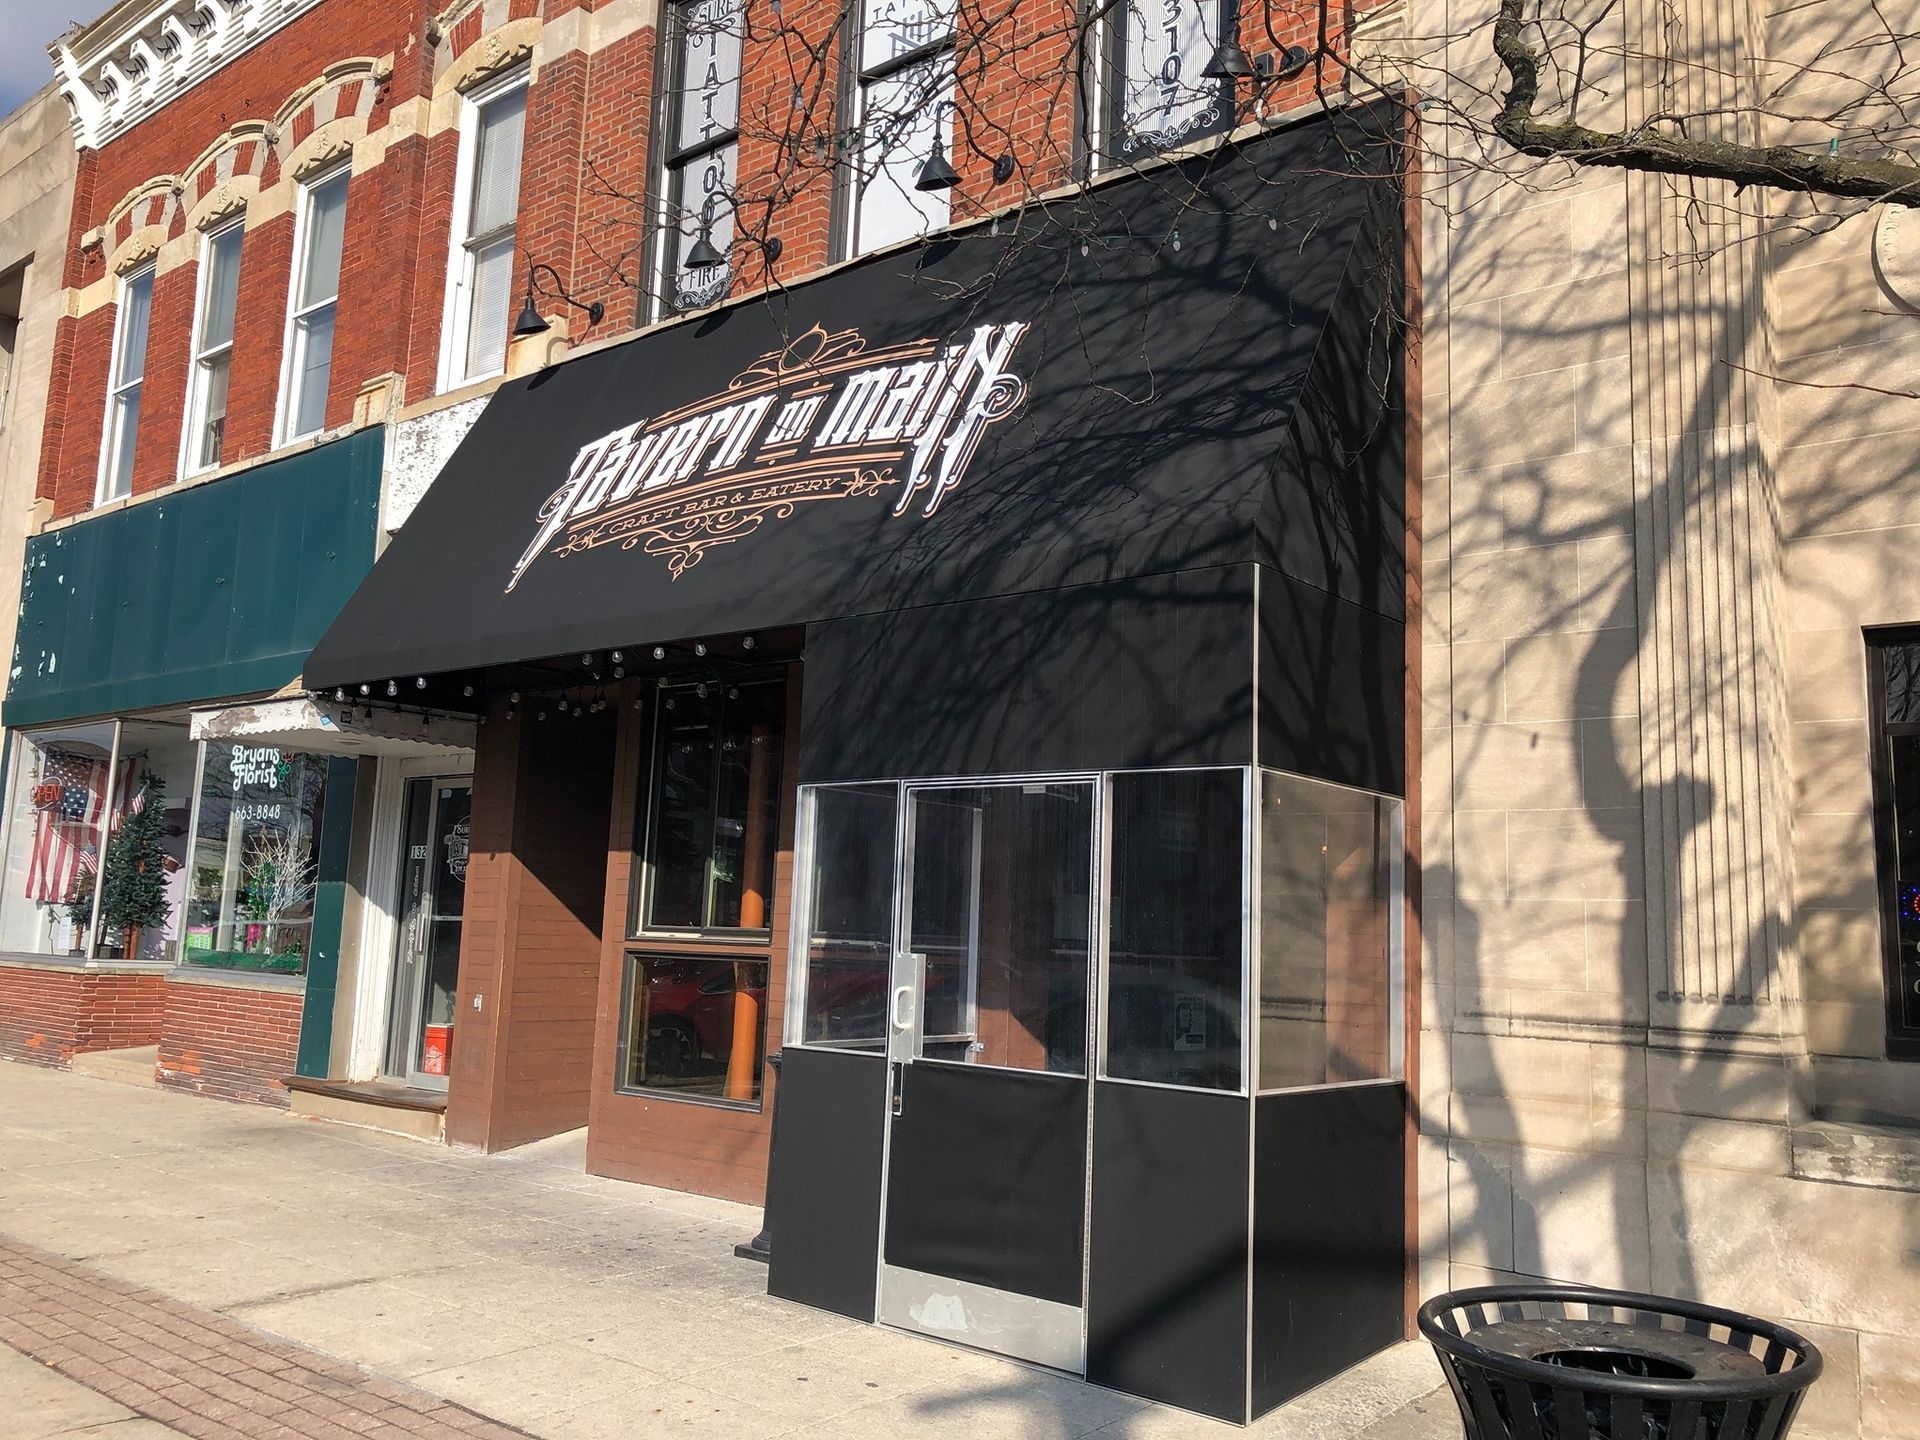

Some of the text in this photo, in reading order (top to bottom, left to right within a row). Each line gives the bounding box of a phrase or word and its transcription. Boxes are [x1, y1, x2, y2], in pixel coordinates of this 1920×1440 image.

[688, 266, 721, 290] FIRE
[609, 478, 841, 534] CRAFT BAR & EATERY
[231, 745, 280, 770] Bryans
[230, 762, 277, 791] Florist
[30, 784, 61, 802] OPEN
[235, 804, 280, 820] 663-8848
[412, 846, 426, 858] 132
